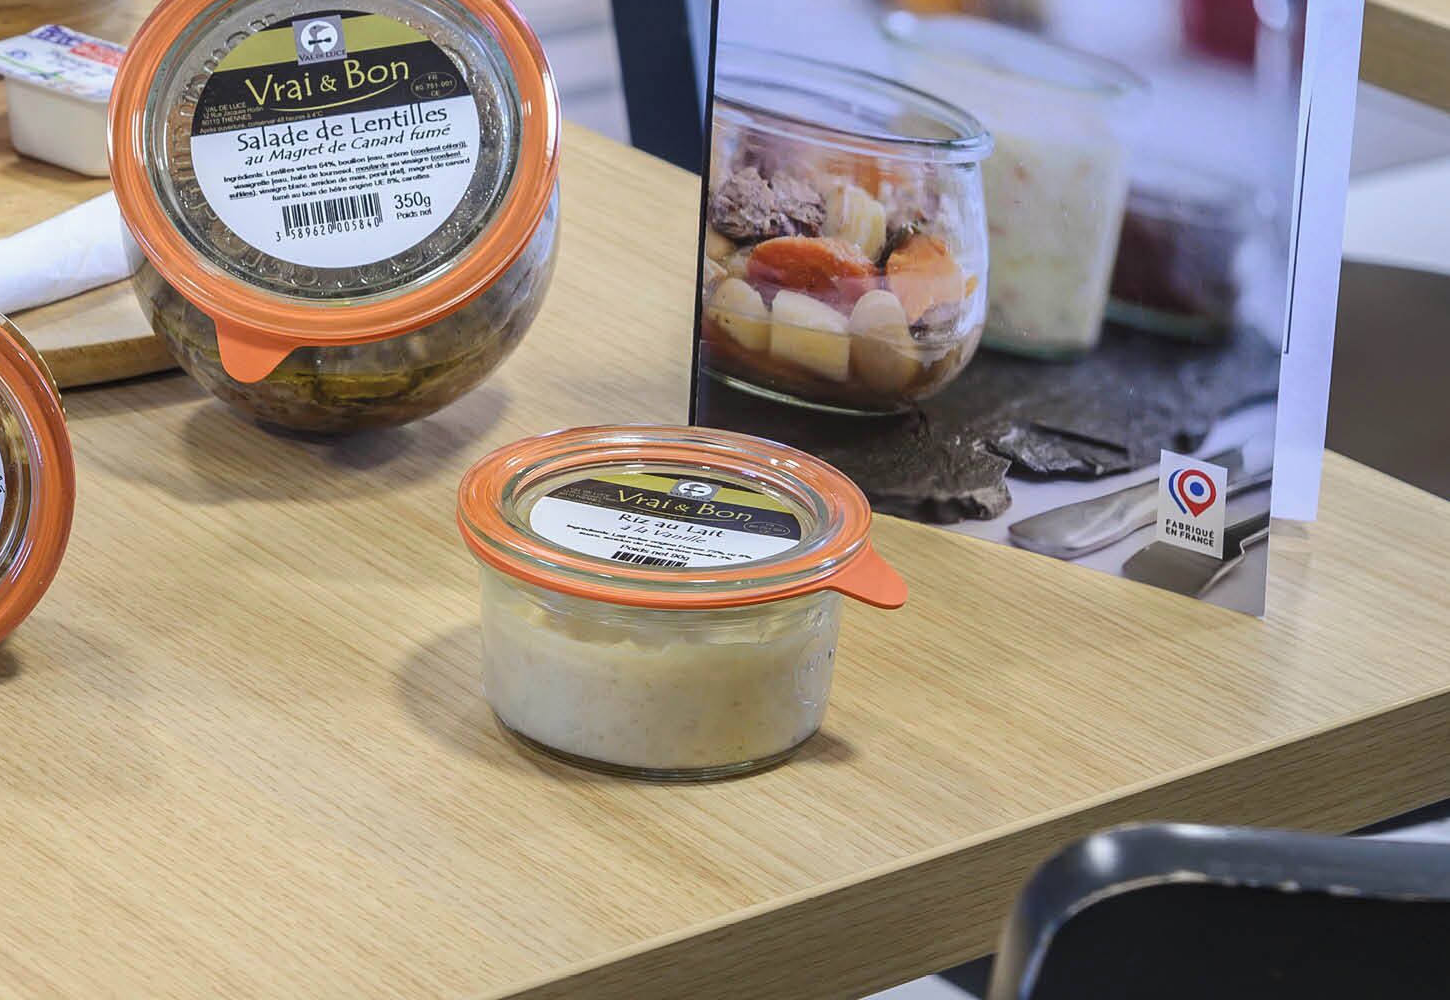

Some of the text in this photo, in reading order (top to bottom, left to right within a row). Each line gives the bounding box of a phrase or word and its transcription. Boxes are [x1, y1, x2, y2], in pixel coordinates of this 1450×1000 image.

[299, 54, 313, 62] VAL
[244, 51, 411, 108] Vrai & Bon
[204, 105, 217, 113] VAL
[228, 101, 246, 110] LUCE
[235, 98, 448, 153] Salade de Lentilles
[243, 121, 452, 166] au Magret de Canard fumé
[265, 166, 295, 176] Lentilles
[337, 156, 366, 166] bouillon
[434, 160, 444, 168] de
[392, 189, 432, 211] 350g
[396, 207, 432, 220] Poids net
[274, 231, 282, 242] 3
[615, 488, 672, 510] Vrai
[673, 502, 692, 513] &
[696, 502, 753, 522] Bon
[618, 512, 648, 525] Riz
[654, 520, 678, 531] au
[686, 524, 726, 539] Lait
[633, 524, 647, 534] la
[653, 528, 707, 544] Vanille
[1166, 519, 1215, 539] FABRIQUÉ
[1165, 527, 1214, 547] EN FRANCE
[619, 543, 690, 561] Poids net 90g
